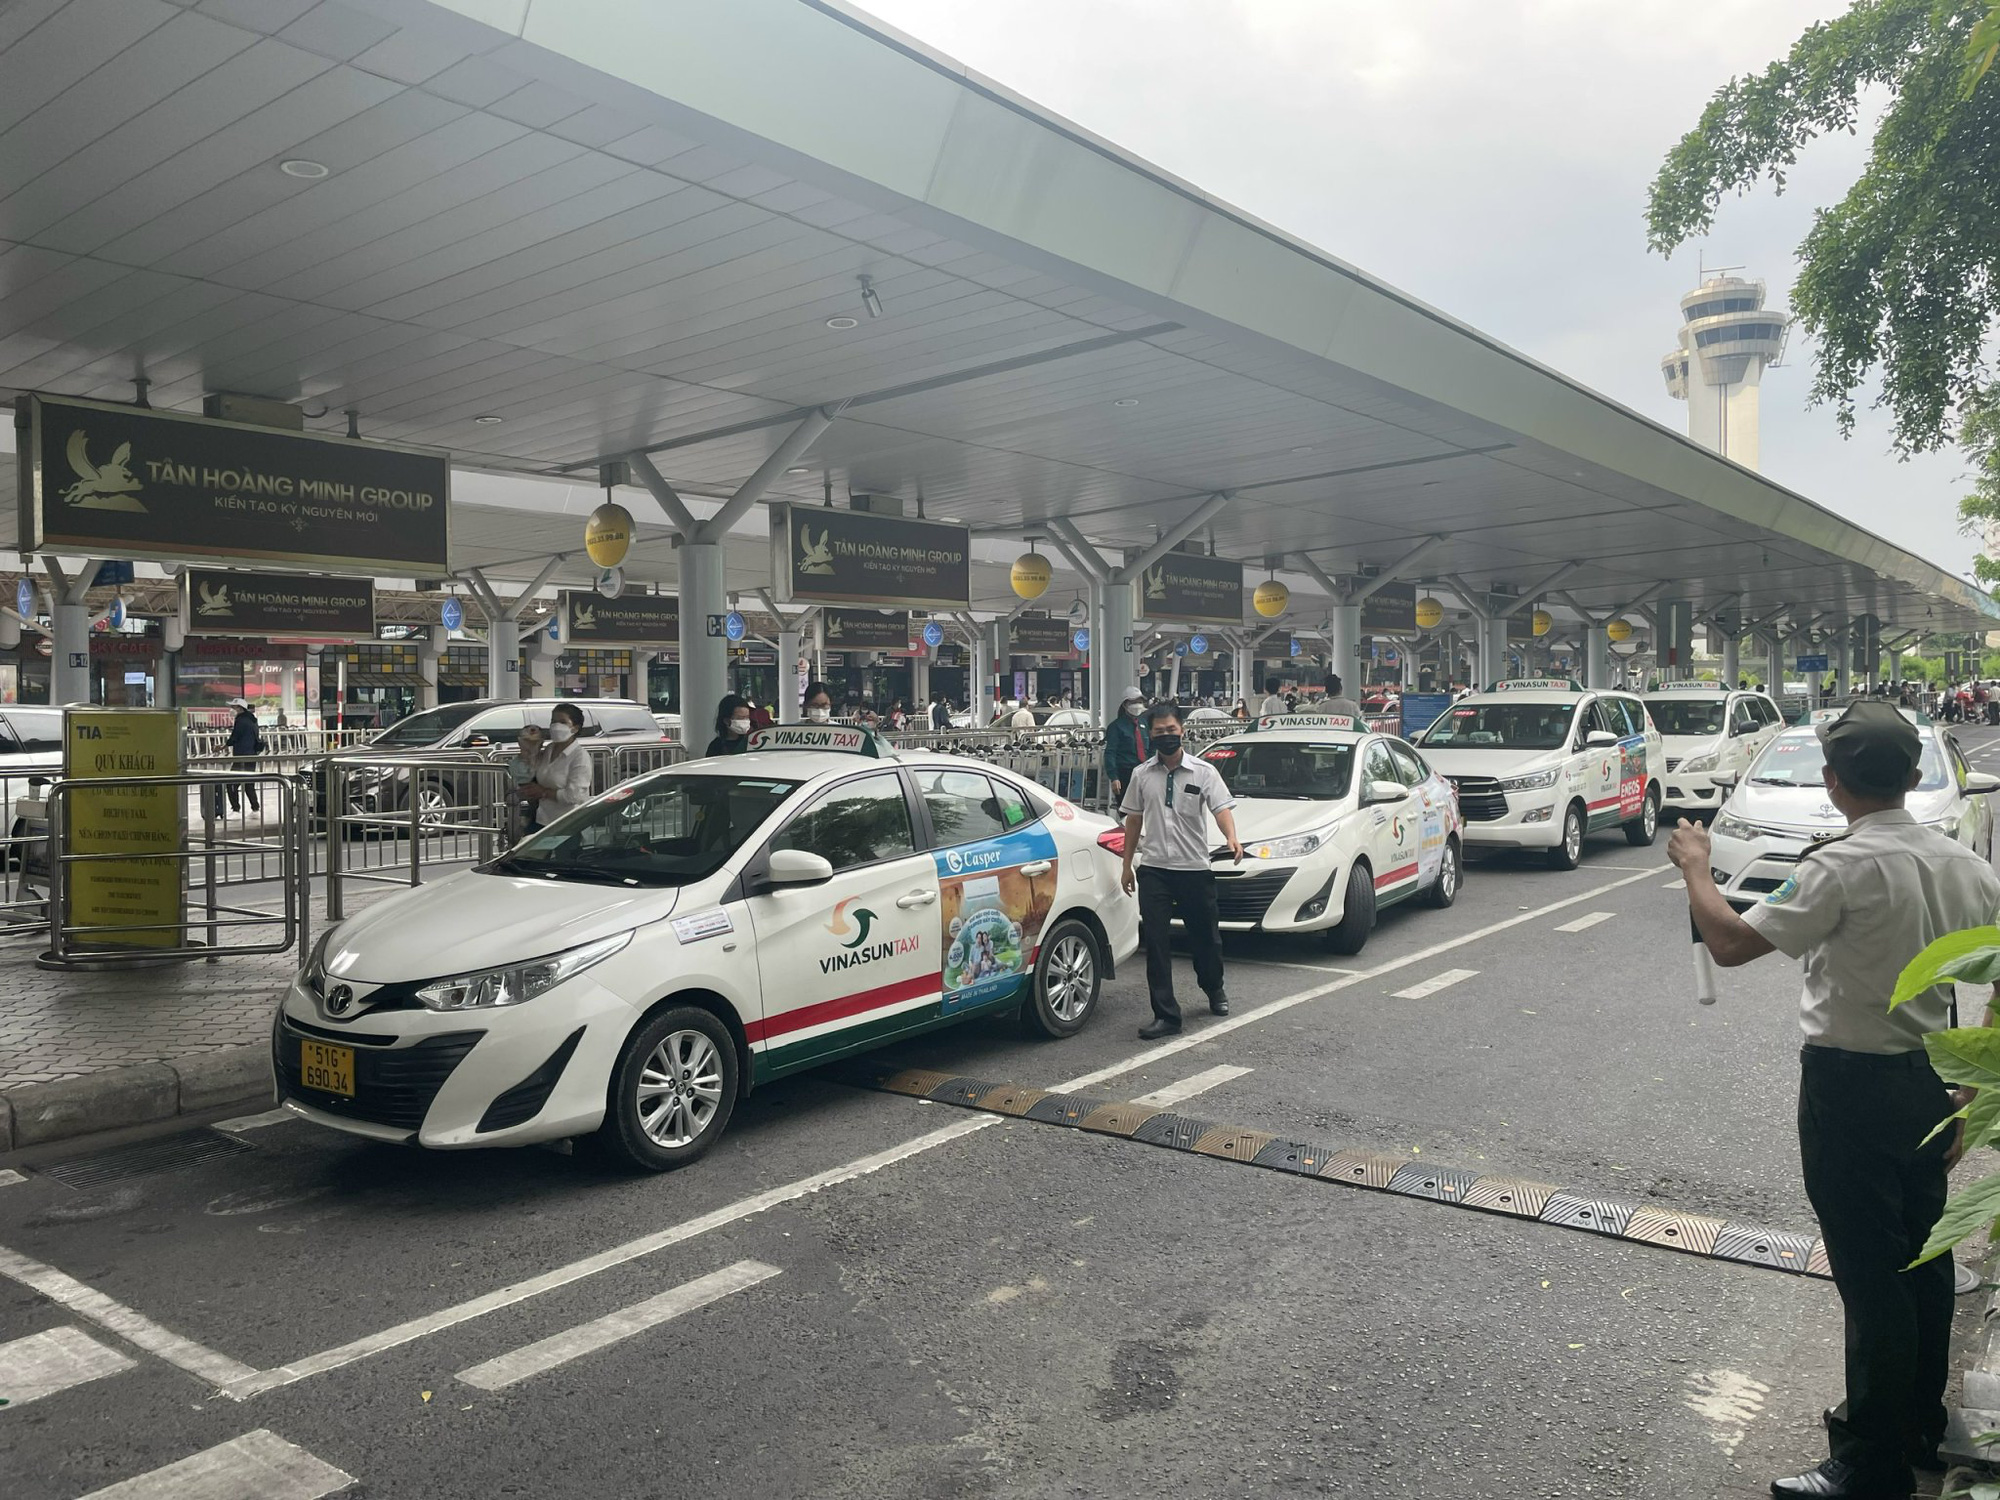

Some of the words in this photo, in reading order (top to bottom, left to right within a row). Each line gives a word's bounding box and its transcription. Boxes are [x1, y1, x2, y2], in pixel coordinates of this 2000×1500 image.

[146, 457, 196, 487] TÂN
[203, 465, 294, 496] HOÀNG
[300, 479, 355, 503] MINH
[360, 487, 433, 512] GROUP
[214, 495, 246, 510] KIẾN
[301, 505, 353, 520] NGUYÊN
[834, 538, 856, 555] TÂN
[858, 541, 899, 559] HOÀNG
[900, 547, 926, 561] MINH
[927, 550, 962, 565] GROUP
[233, 590, 256, 603] TÂN
[258, 592, 299, 605] HOÀNG
[301, 595, 328, 605] MINH
[330, 597, 367, 608] GROUP
[641, 612, 659, 620] MINH
[1280, 717, 1327, 726] VINASUN
[1329, 718, 1350, 726] TAXI
[76, 726, 102, 739] TIA
[774, 731, 832, 746] VINASUN
[833, 733, 860, 747] TAXI
[95, 750, 116, 772] QUÝ
[119, 750, 155, 770] KHÁCH
[964, 850, 1001, 868] Casper
[316, 1046, 338, 1067] 51G
[308, 1066, 348, 1092] 690.34
